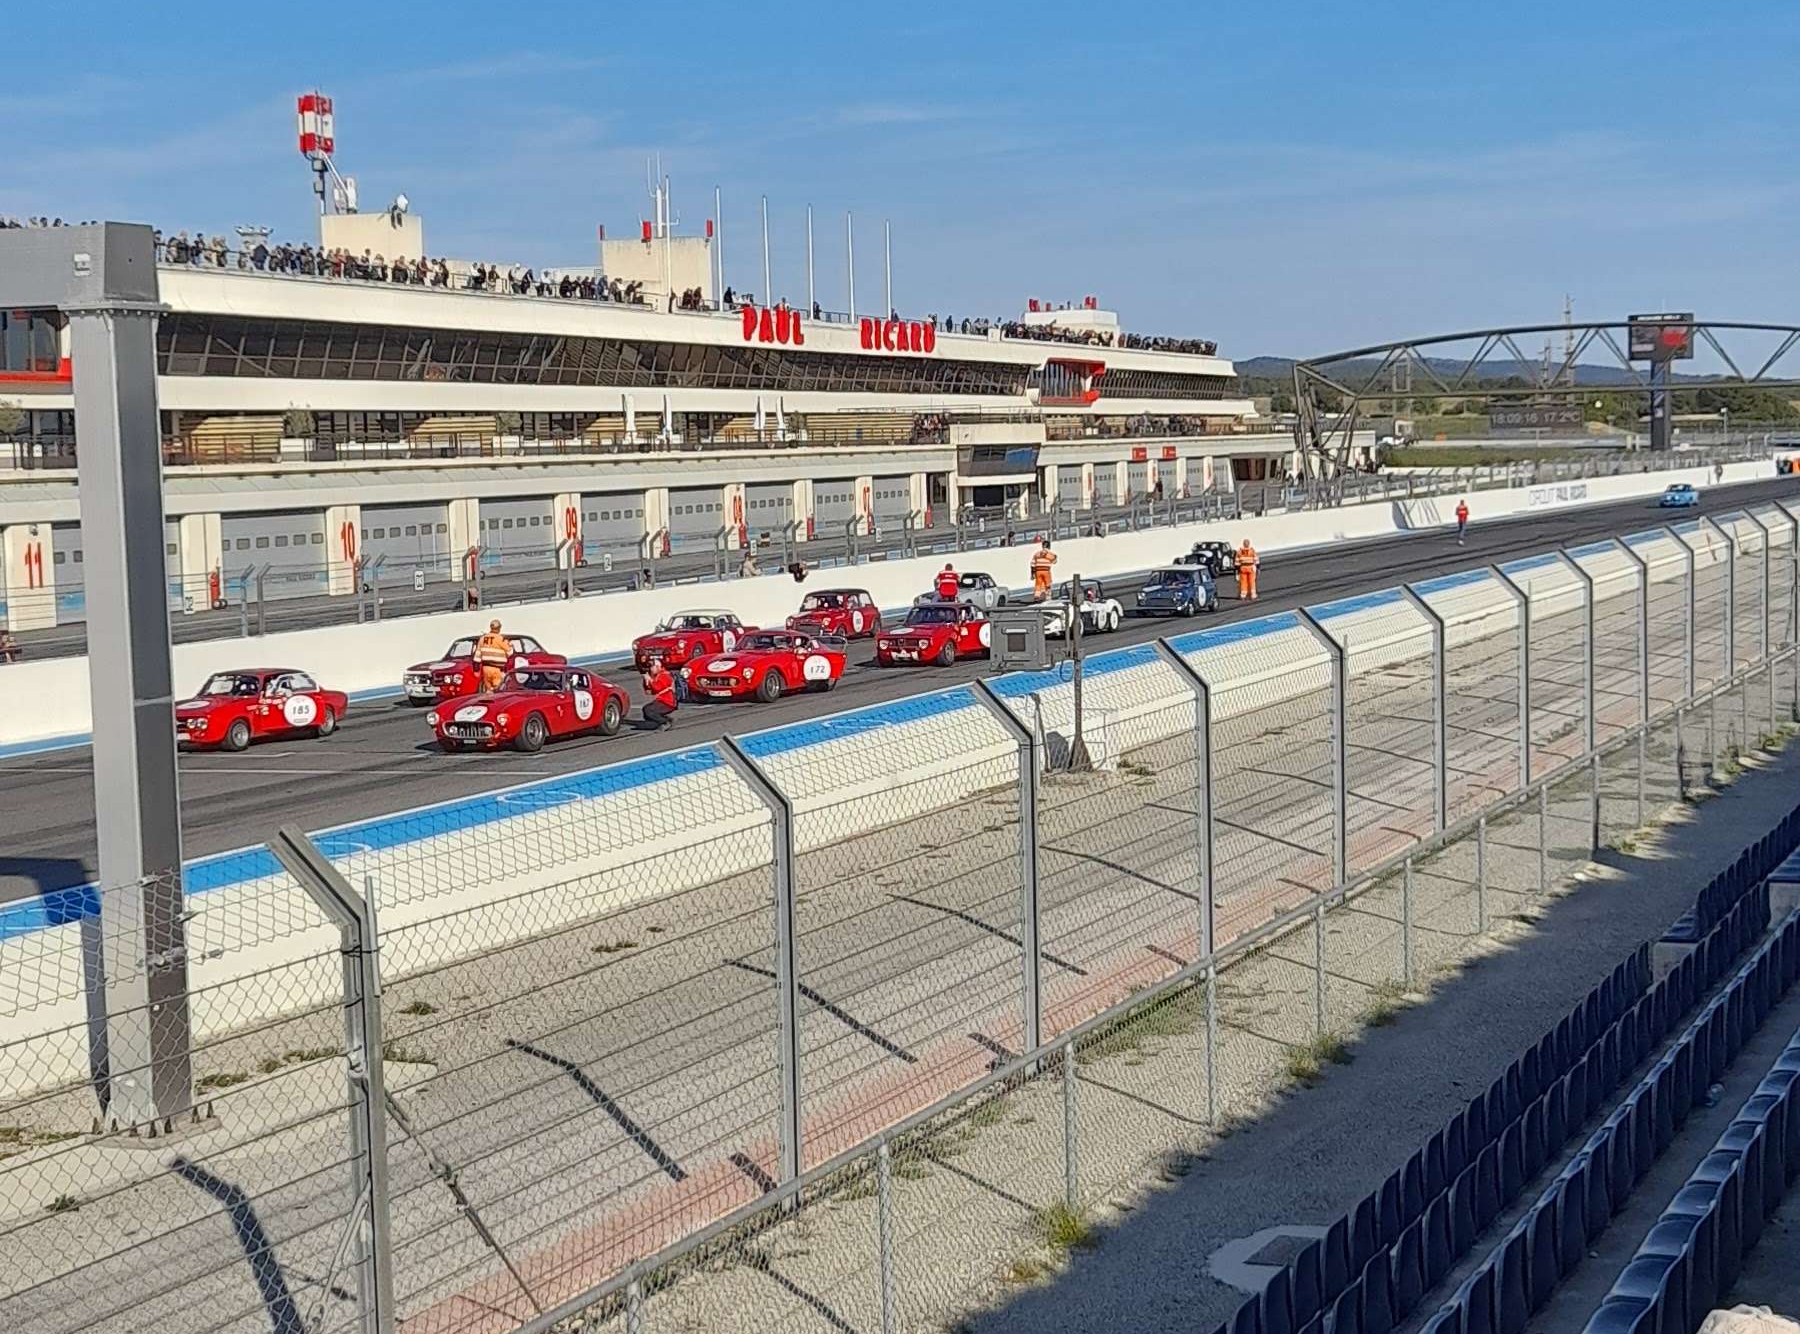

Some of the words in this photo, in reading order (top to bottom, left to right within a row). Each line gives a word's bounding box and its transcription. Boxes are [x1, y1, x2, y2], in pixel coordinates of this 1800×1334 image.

[742, 306, 804, 346] PAUL
[860, 318, 936, 353] RICARD
[340, 521, 355, 561] 10
[566, 507, 577, 540] 09
[25, 542, 43, 590] 11
[810, 665, 825, 674] 172
[292, 705, 310, 715] 185
